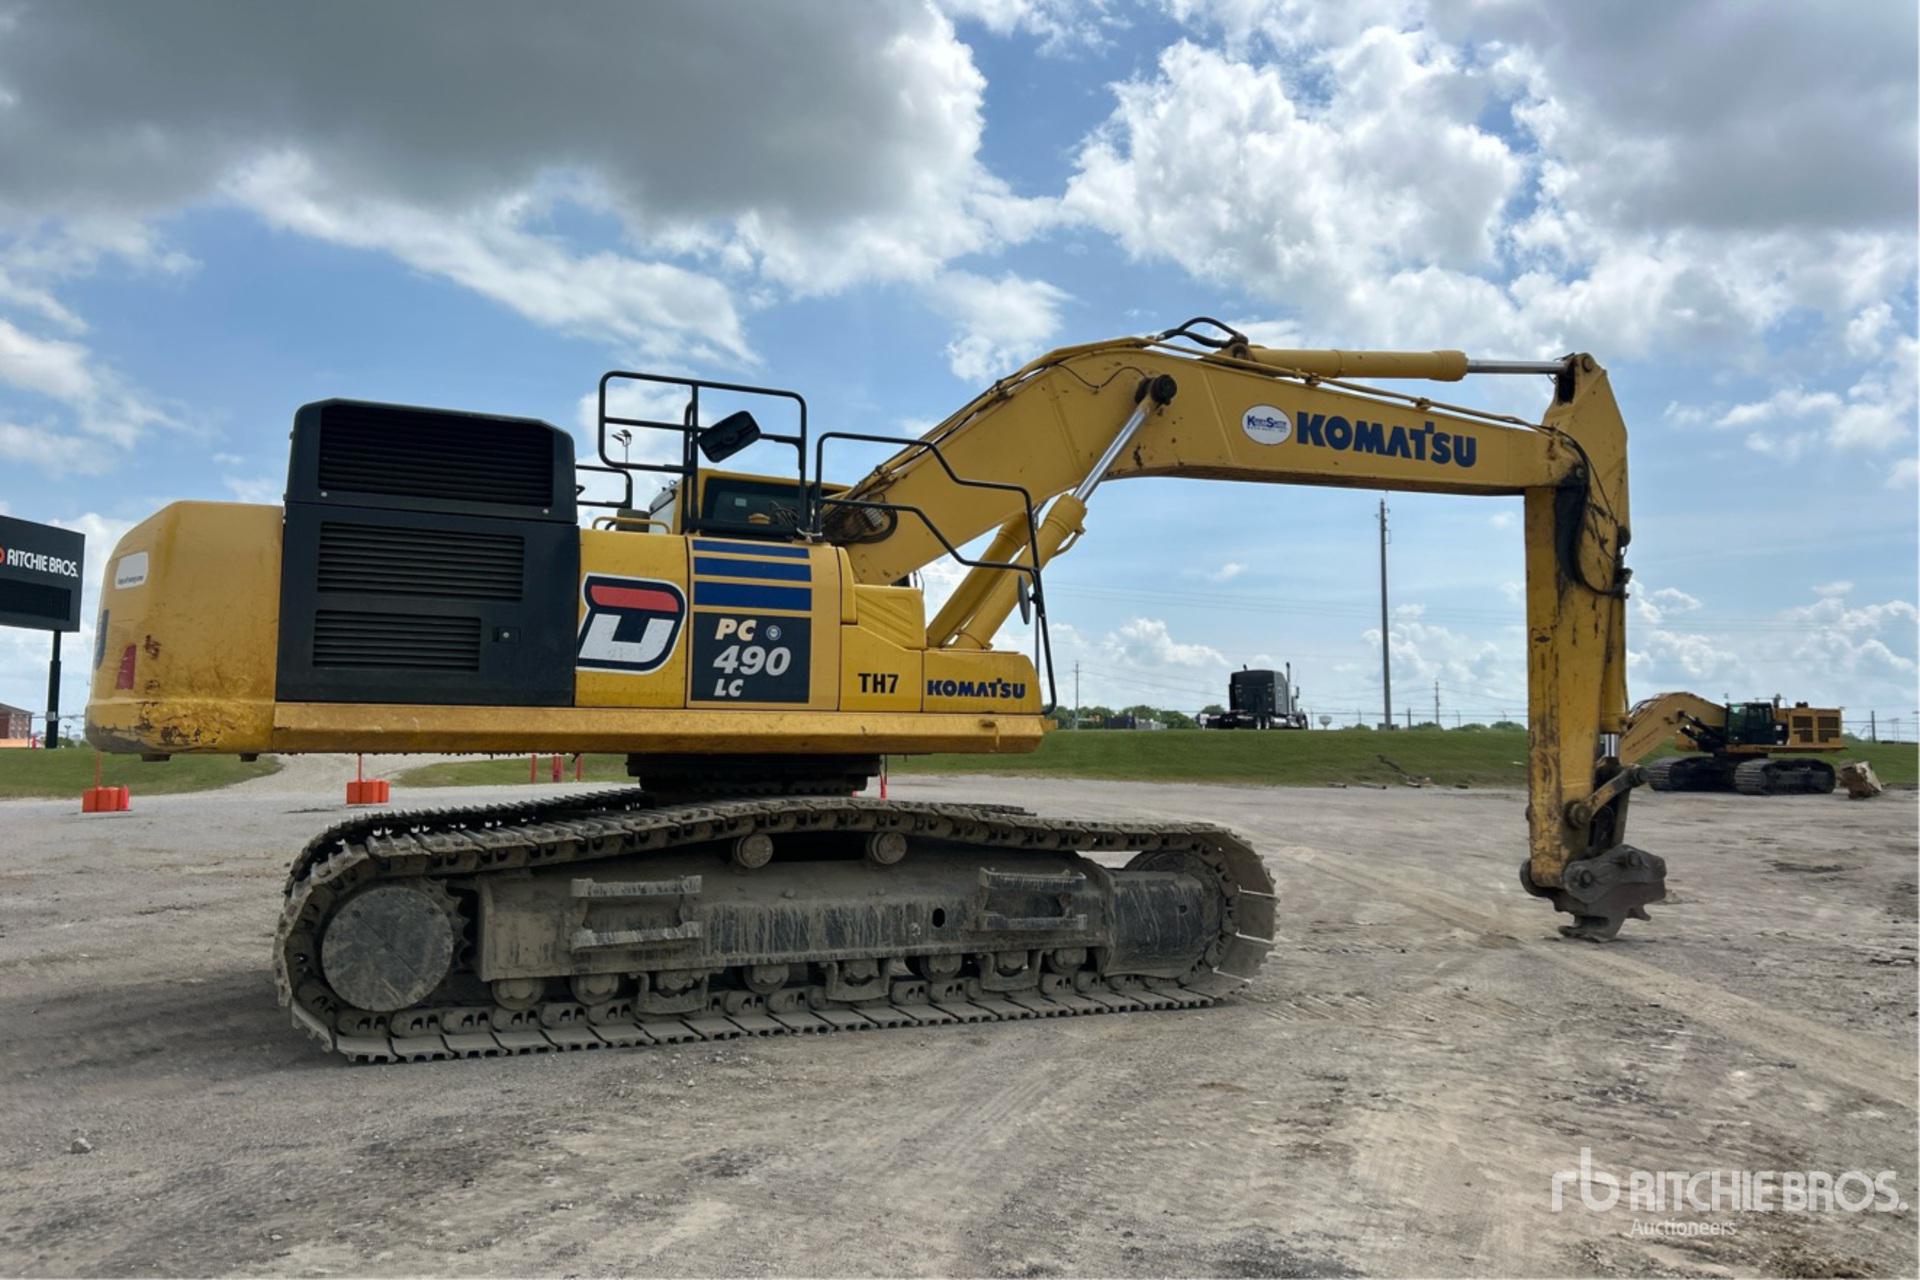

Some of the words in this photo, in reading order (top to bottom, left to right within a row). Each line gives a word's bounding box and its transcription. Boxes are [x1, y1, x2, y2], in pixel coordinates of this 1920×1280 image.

[1297, 411, 1477, 468] KOMATSU
[7, 548, 48, 572] RITCHIE
[715, 618, 757, 641] PC
[713, 645, 792, 677] 490
[713, 679, 744, 697] LC
[858, 673, 899, 694] TH7
[927, 678, 1026, 699] KOMATSU
